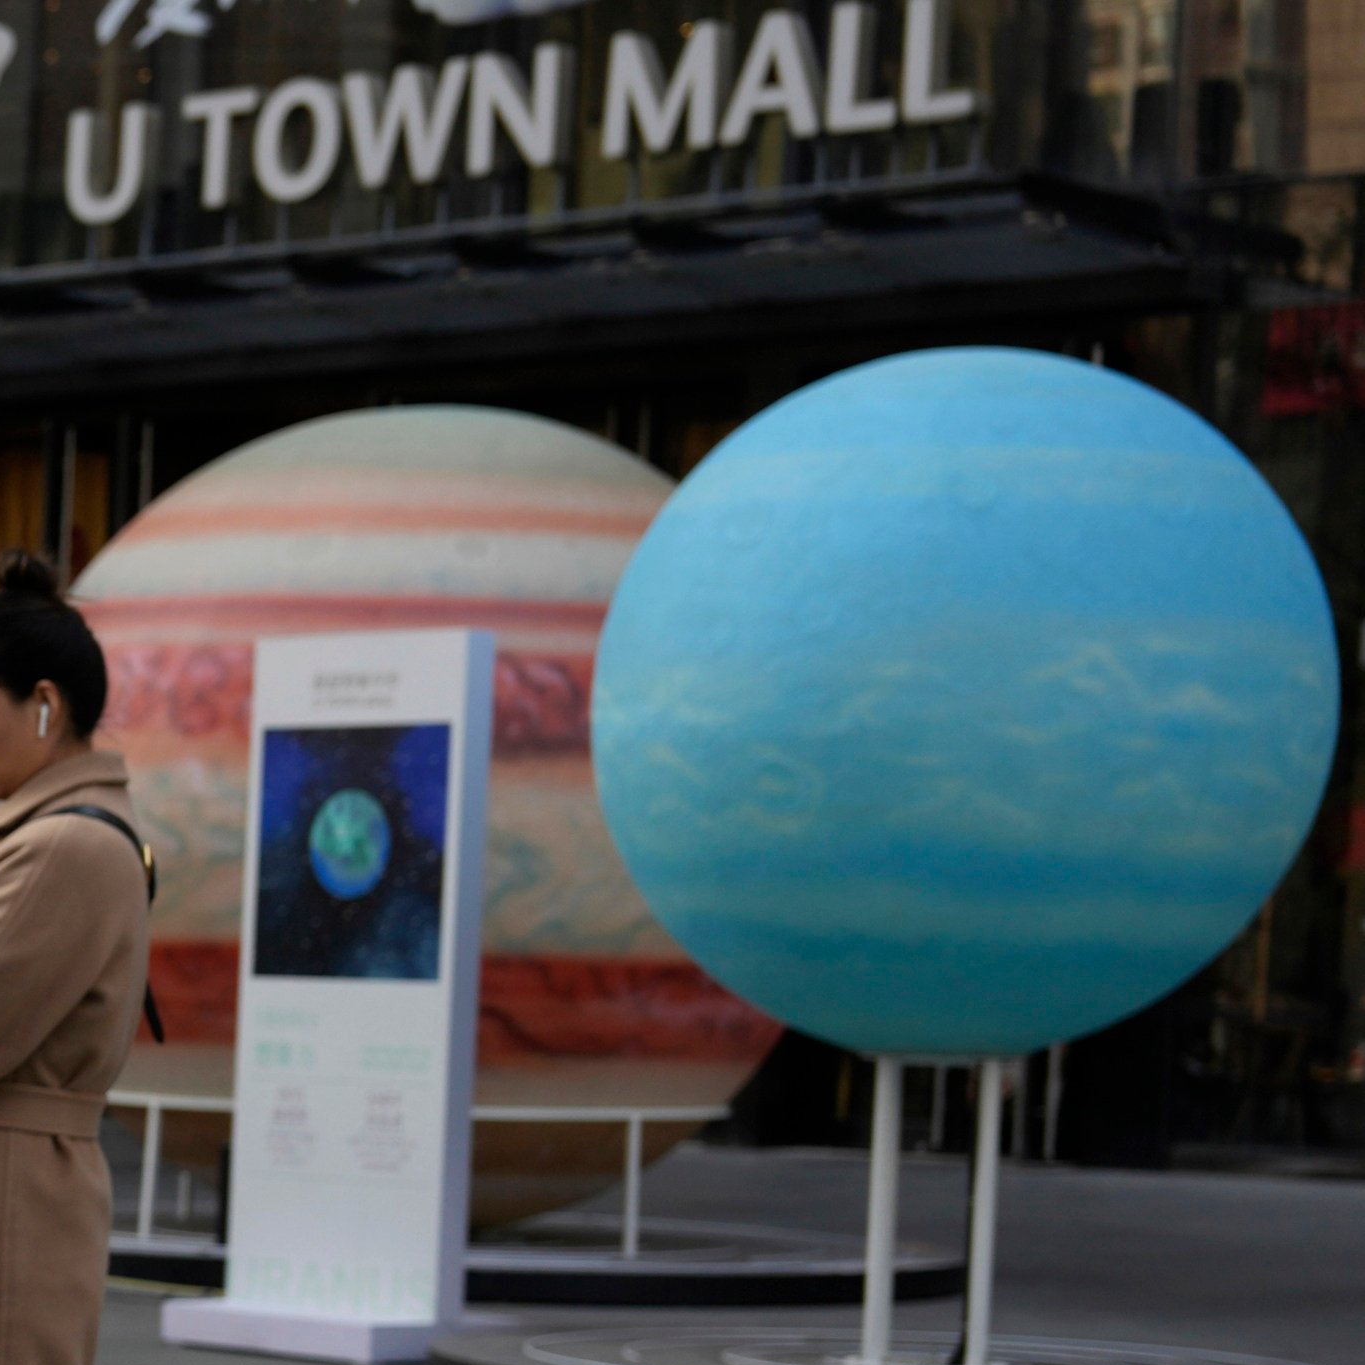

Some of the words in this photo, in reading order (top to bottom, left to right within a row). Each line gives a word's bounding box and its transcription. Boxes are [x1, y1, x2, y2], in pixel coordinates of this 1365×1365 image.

[64, 102, 157, 225] U
[181, 38, 574, 210] TOWN
[600, 0, 988, 162] MALL
